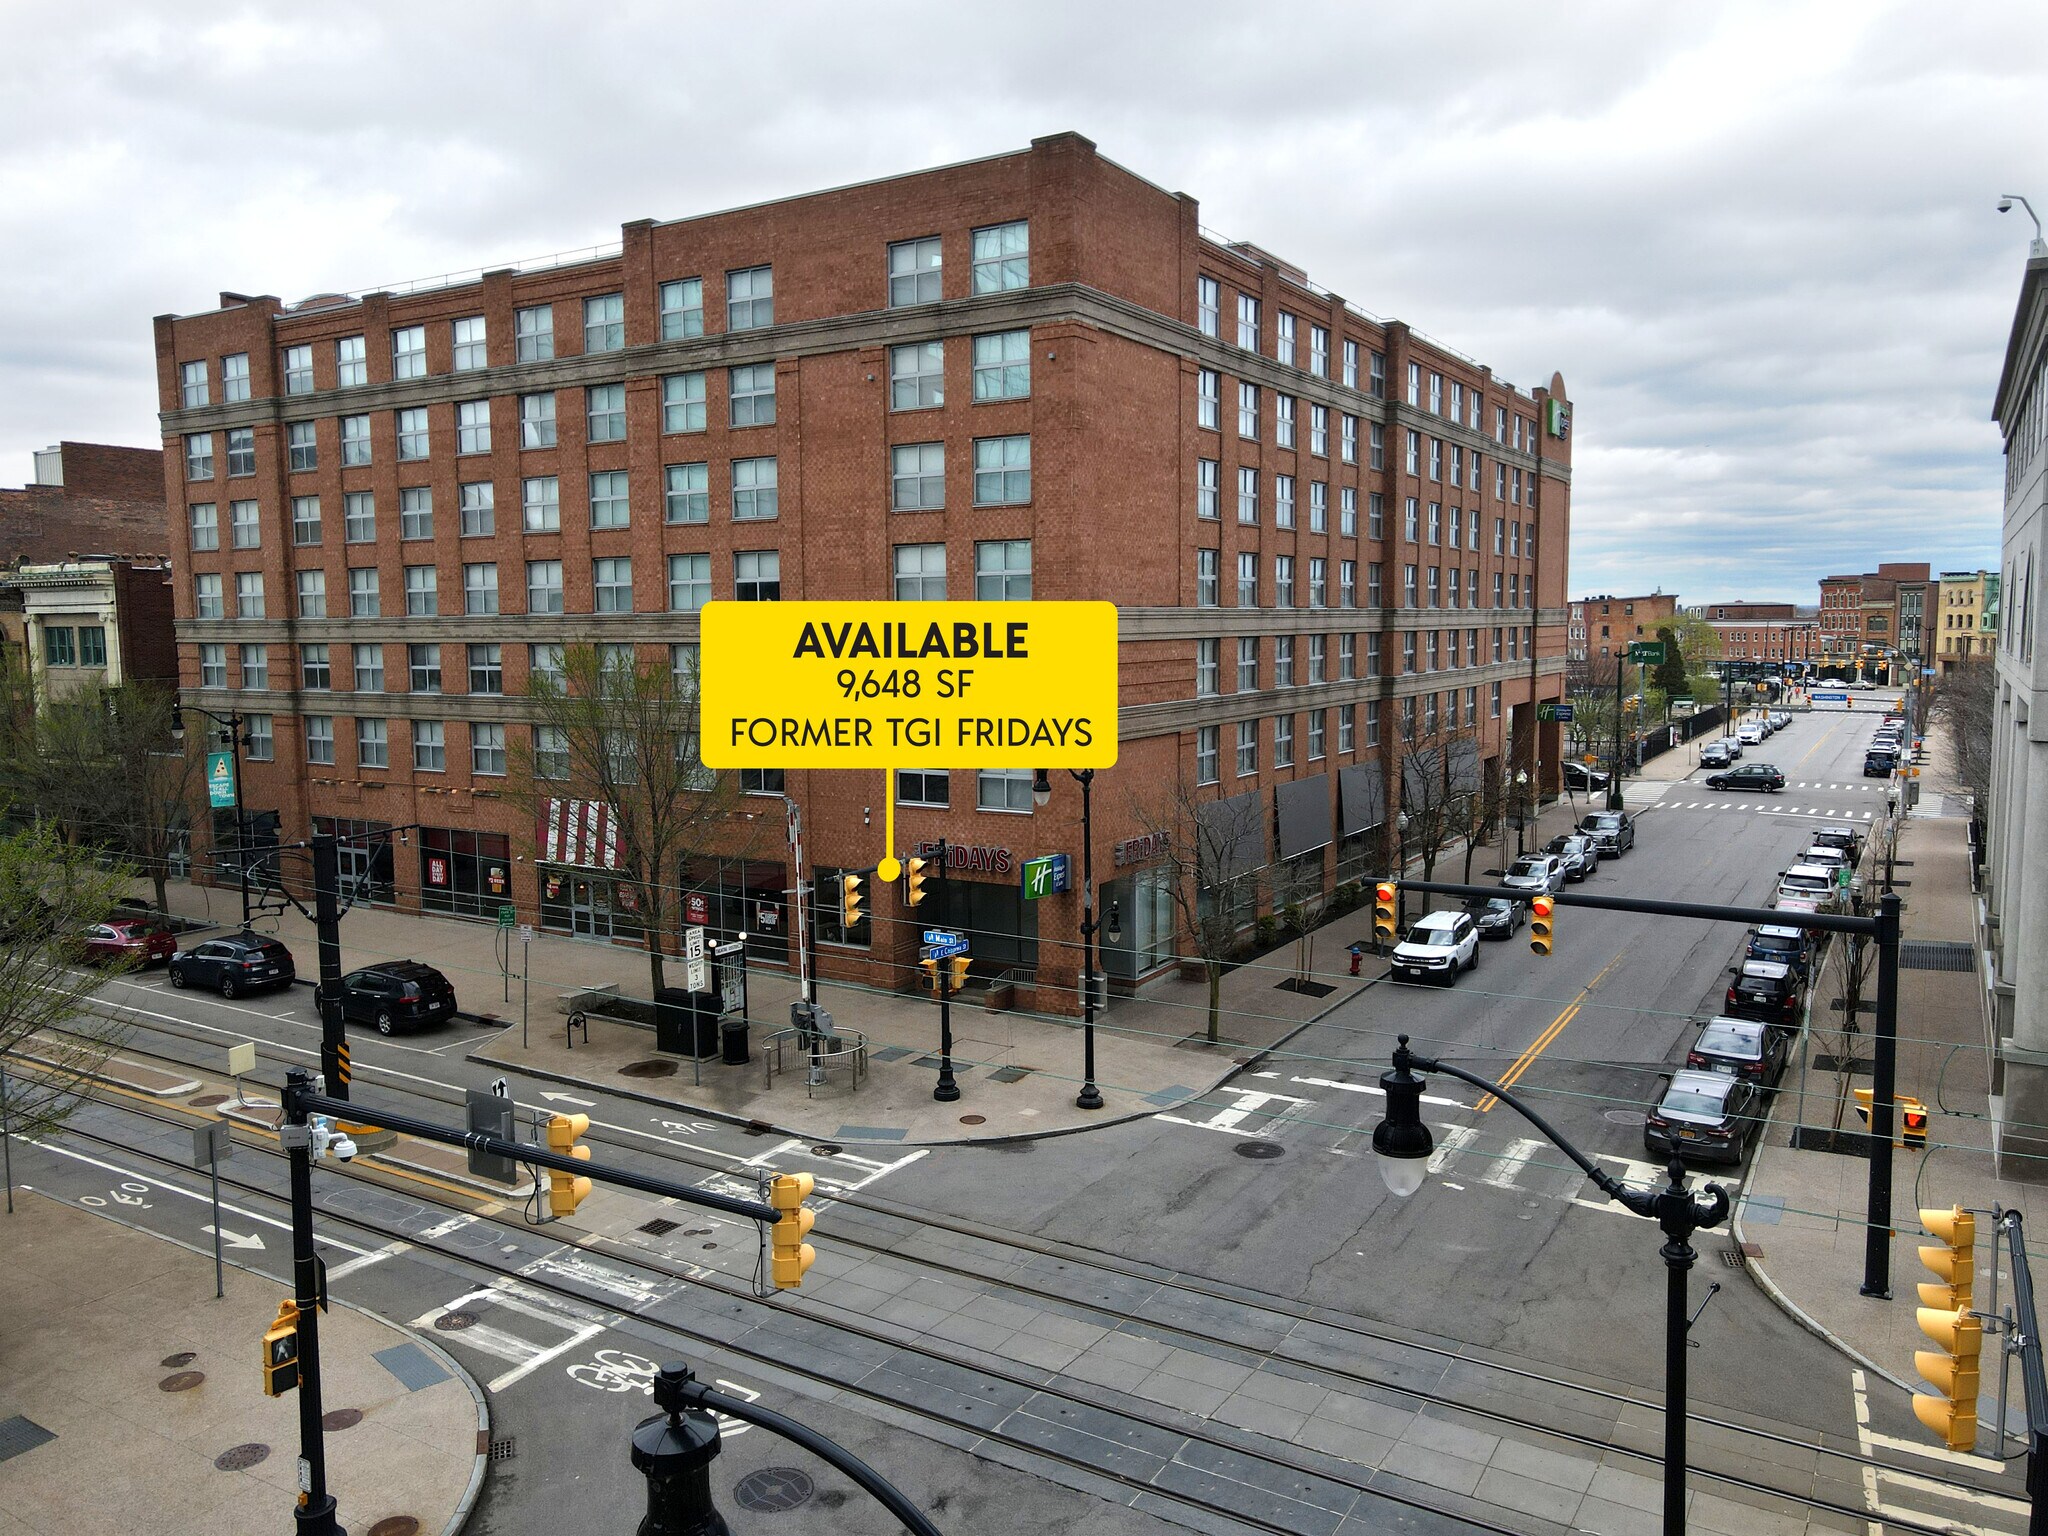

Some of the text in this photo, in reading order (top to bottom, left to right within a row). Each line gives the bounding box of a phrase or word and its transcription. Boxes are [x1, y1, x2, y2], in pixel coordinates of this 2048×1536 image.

[935, 934, 948, 943] Main
[690, 945, 701, 958] 15
[689, 980, 704, 989] TONS
